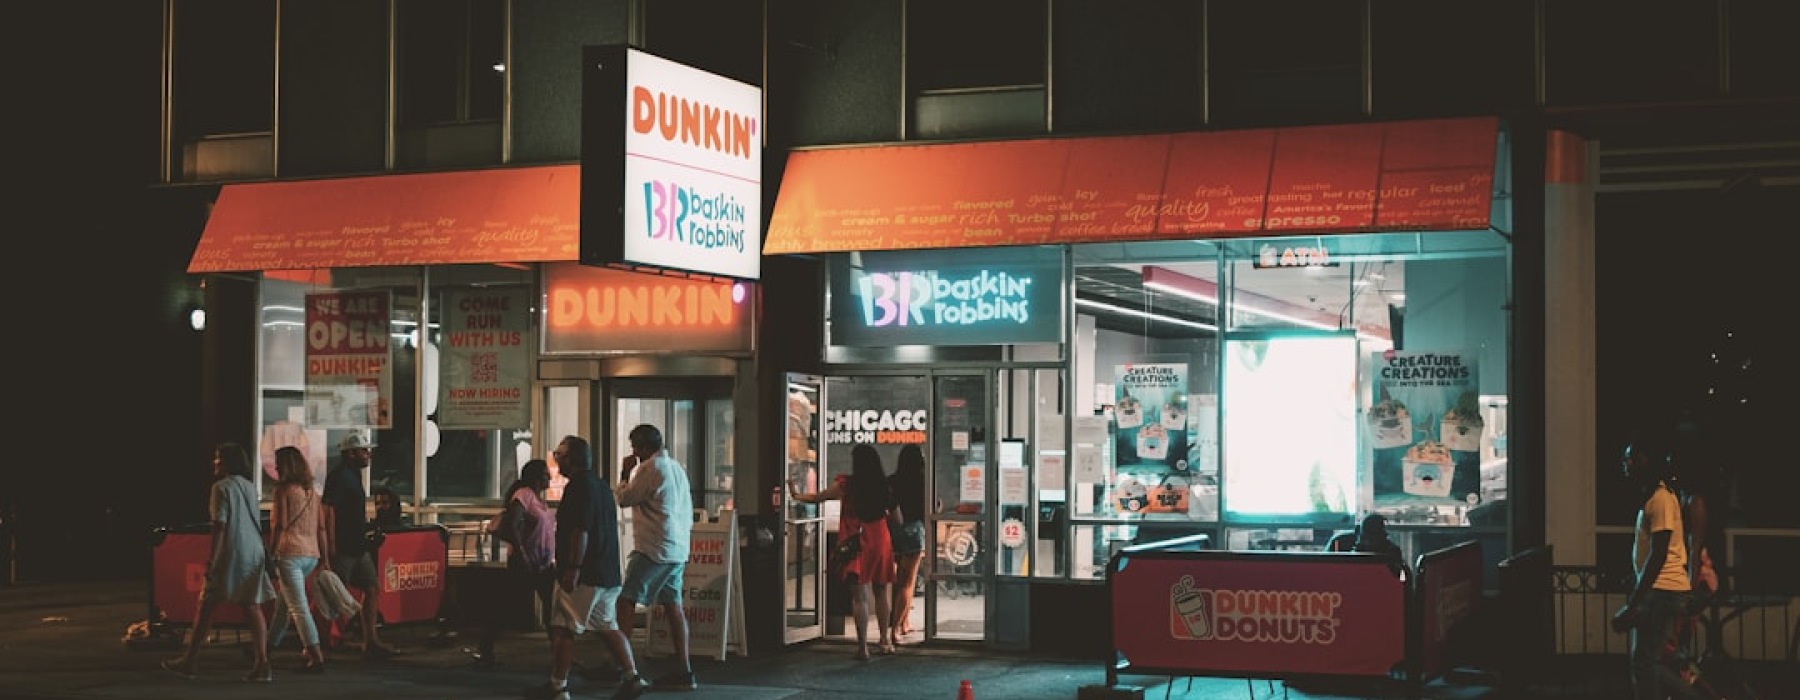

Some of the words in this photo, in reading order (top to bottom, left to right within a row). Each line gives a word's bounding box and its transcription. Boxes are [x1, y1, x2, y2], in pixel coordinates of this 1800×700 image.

[633, 85, 756, 159] DUNKIN'
[643, 180, 690, 242] BR
[689, 187, 745, 224] baskin
[1008, 213, 1056, 224] Turbo
[1059, 211, 1097, 222] shot
[690, 222, 744, 254] robbins
[315, 298, 340, 316] WE
[344, 296, 379, 313] ARE
[459, 296, 510, 312] COME
[552, 283, 745, 327] DUNKIN'
[859, 271, 932, 327] BR
[466, 314, 501, 329] RUN
[934, 297, 1029, 325] robbins
[309, 319, 387, 350] OPEN
[448, 331, 495, 347] WITH
[499, 331, 521, 346] US
[309, 356, 386, 376] DUNKIN'
[1390, 353, 1461, 367] CREATURE
[1381, 366, 1469, 379] CREATIONS
[449, 389, 476, 399] NOW
[479, 387, 521, 399] HIRING
[827, 431, 852, 444] UNS
[854, 431, 875, 444] ON
[1215, 591, 1342, 617] DUNKIN'
[1215, 617, 1337, 643] DONUTS
